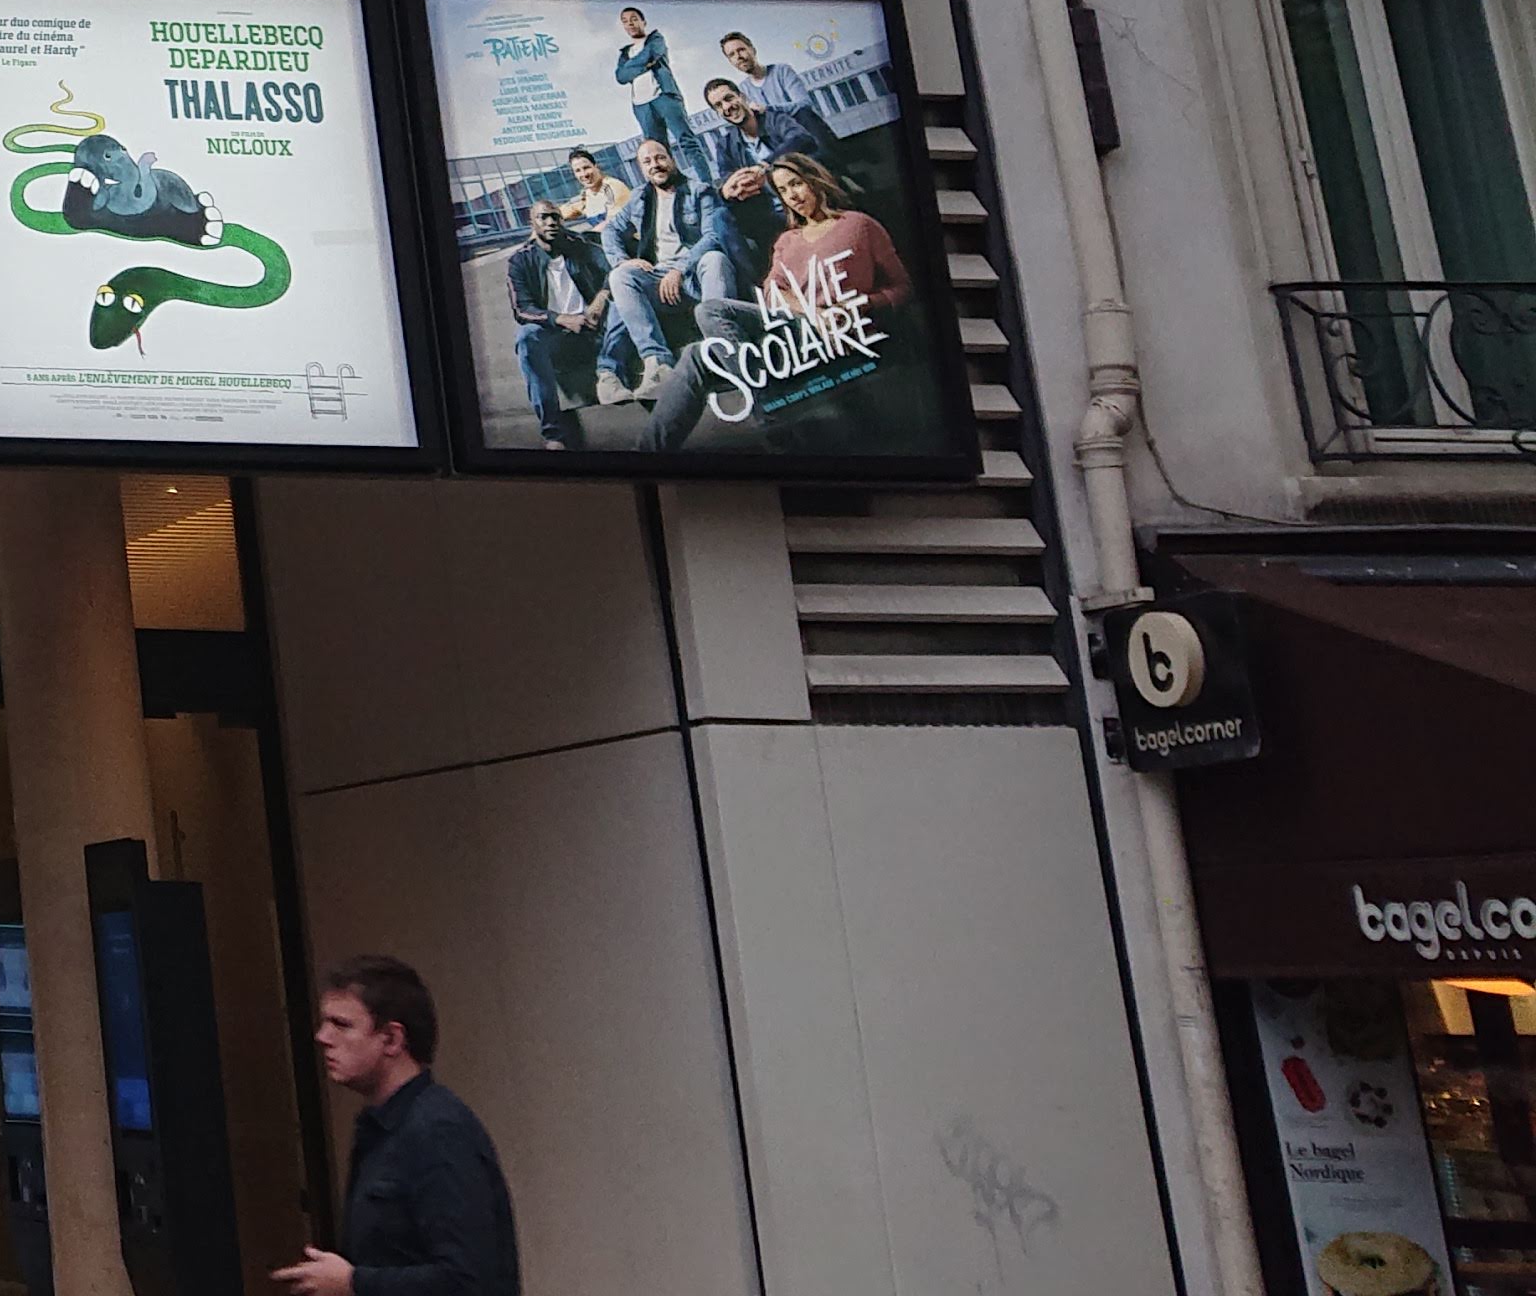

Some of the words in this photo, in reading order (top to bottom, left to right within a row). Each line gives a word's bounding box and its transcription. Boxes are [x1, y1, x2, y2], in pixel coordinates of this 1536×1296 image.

[10, 16, 30, 28] duo
[31, 16, 77, 32] comique
[78, 18, 91, 29] de
[16, 30, 31, 42] du
[33, 30, 74, 42] cinéma
[150, 21, 324, 51] HOUELLEBECQ
[31, 45, 42, 55] et
[168, 48, 310, 73] DEPARDIEU
[483, 33, 559, 66] PATIENTS
[164, 78, 324, 124] THALASSO
[206, 137, 293, 157] NICLOUX
[754, 284, 789, 332] LA
[782, 248, 860, 325] VIE
[699, 294, 890, 424] SCOLAIRE
[1135, 716, 1243, 754] bagelcorner
[1352, 880, 1536, 960] bagelco
